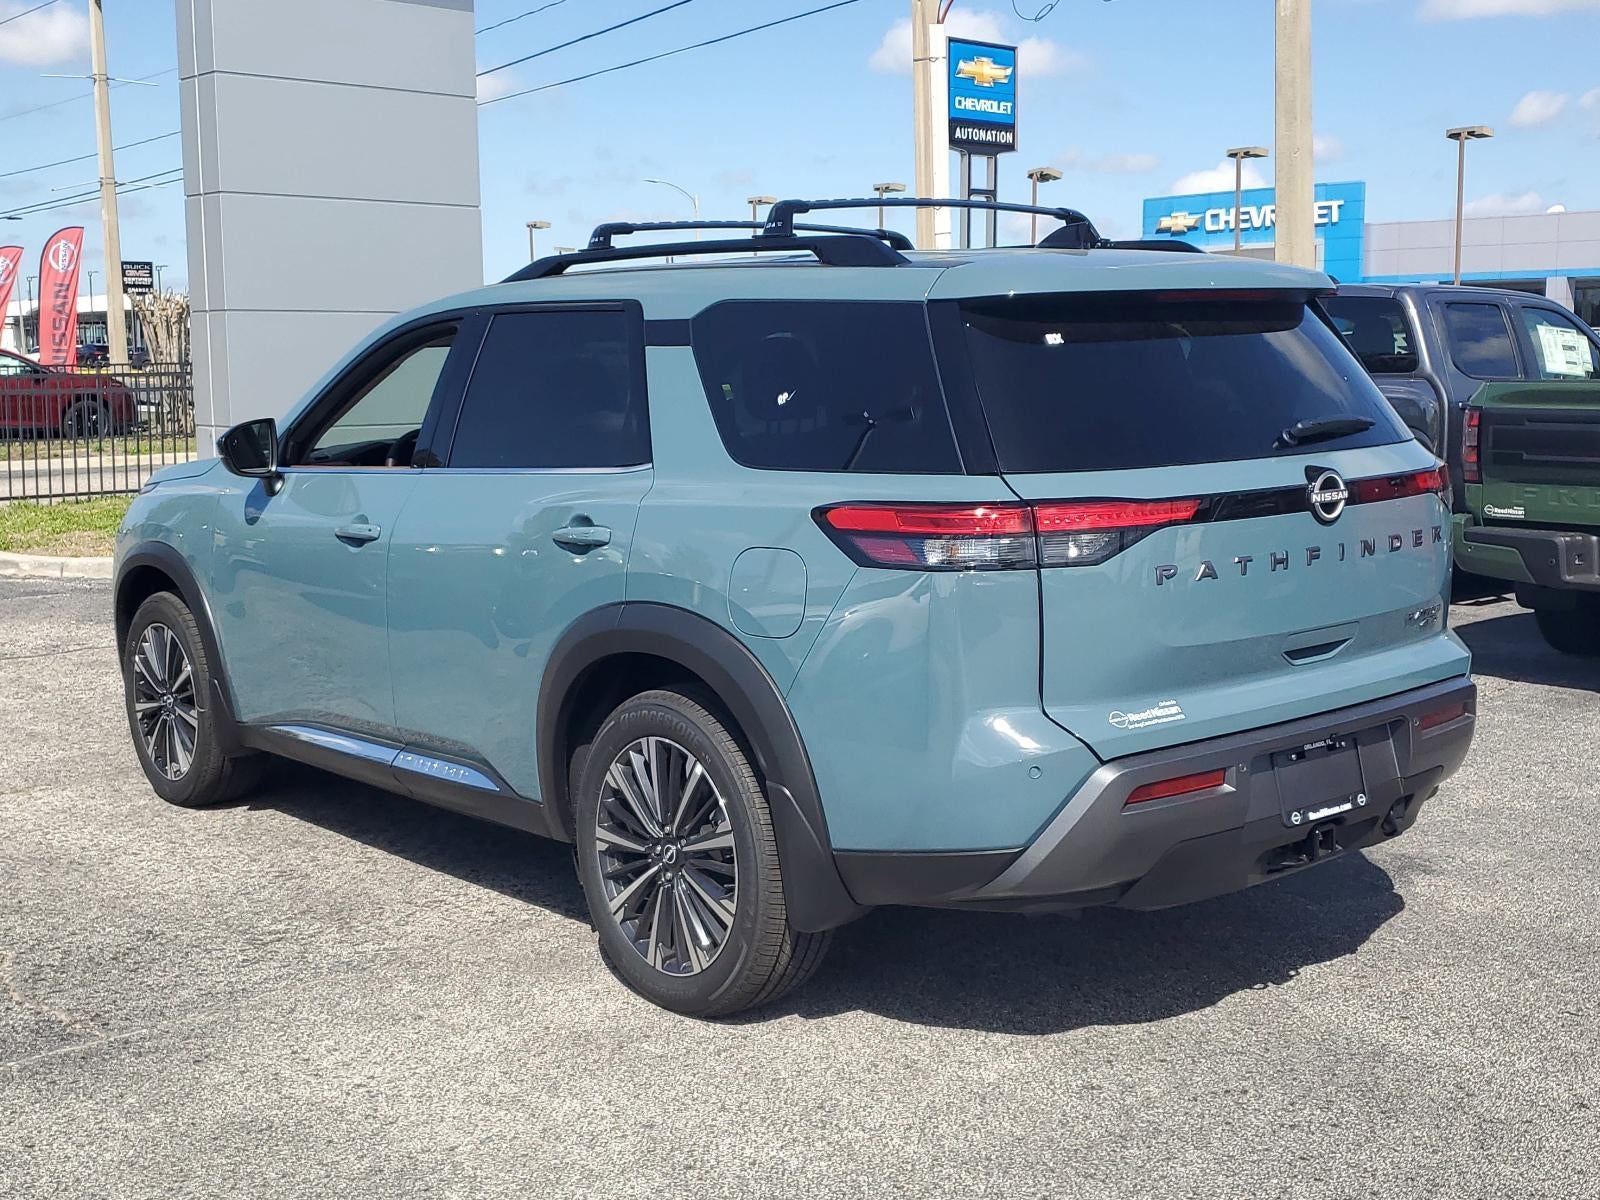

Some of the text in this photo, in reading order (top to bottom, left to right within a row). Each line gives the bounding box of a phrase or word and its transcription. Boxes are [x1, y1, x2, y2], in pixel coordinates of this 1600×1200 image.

[955, 96, 1013, 115] CHEVROLET
[955, 126, 1013, 143] AUTONATION
[1204, 200, 1345, 233] CHEVRET
[60, 242, 69, 272] NISSAN
[1312, 491, 1348, 502] NISSAN
[1155, 525, 1442, 586] PATHFINDER
